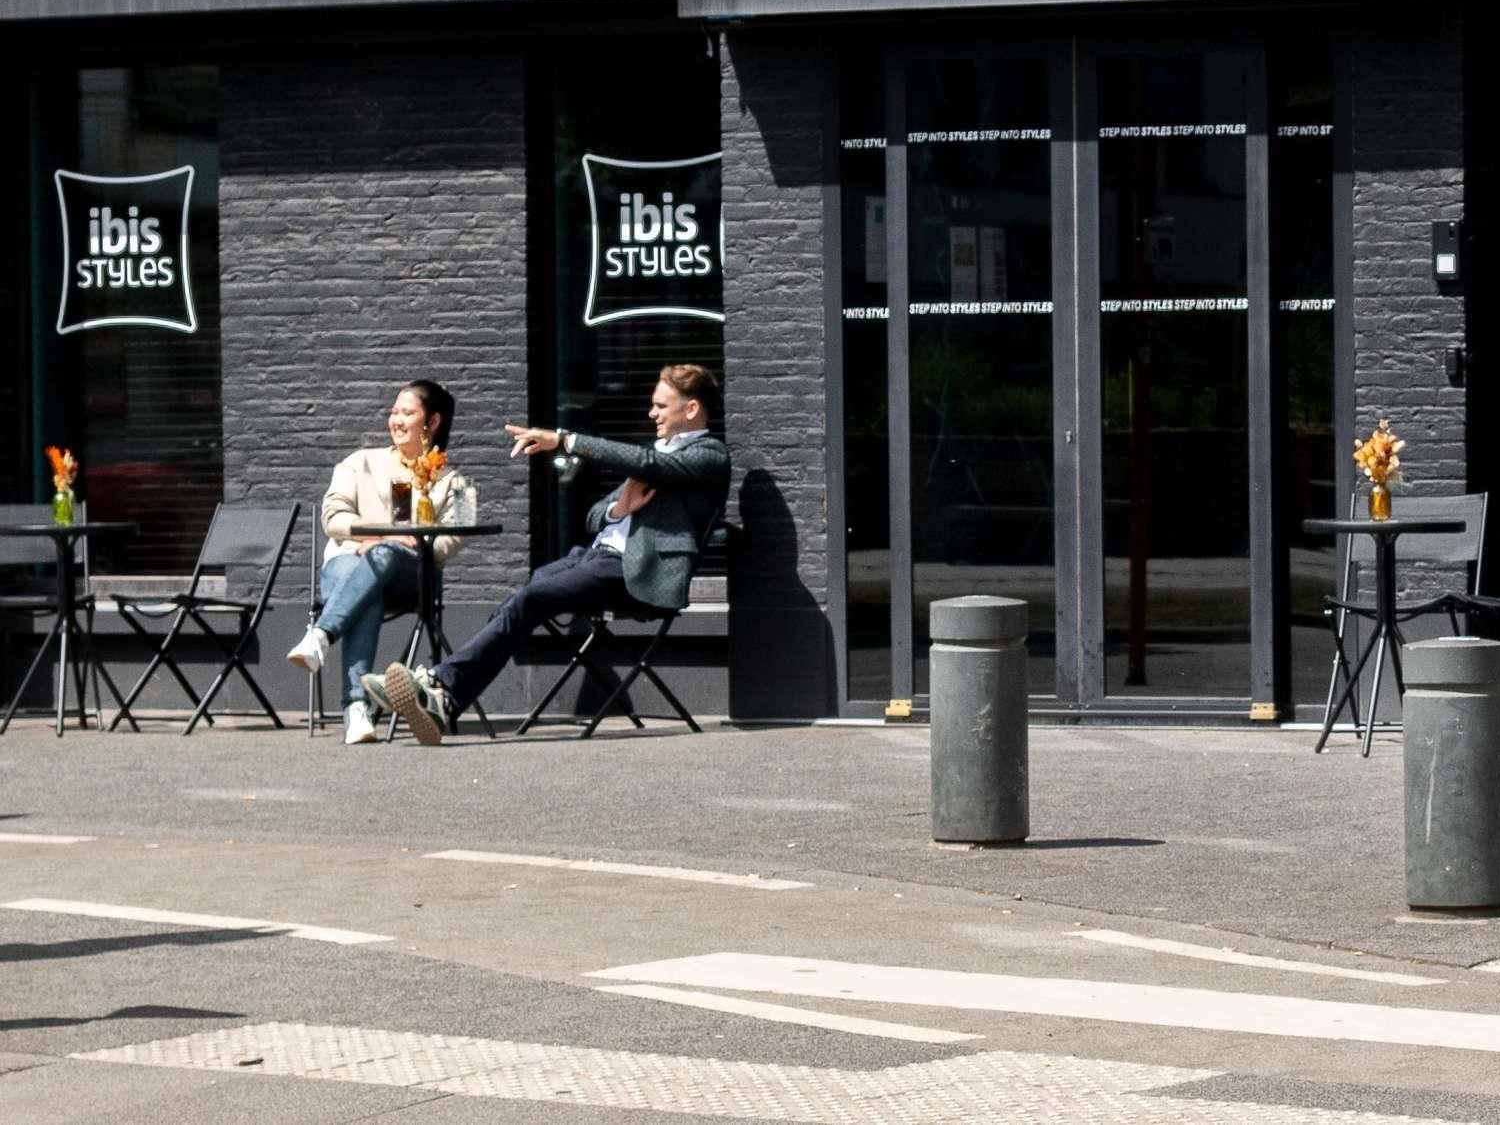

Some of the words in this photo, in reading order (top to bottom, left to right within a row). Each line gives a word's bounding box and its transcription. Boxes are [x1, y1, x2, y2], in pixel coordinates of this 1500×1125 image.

[907, 132, 928, 143] STEP
[928, 132, 947, 142] INTO
[948, 131, 978, 142] STYLES
[979, 131, 1000, 141] STEP
[1000, 130, 1020, 140] INTO
[1020, 129, 1051, 139] STYLES
[1099, 127, 1120, 137] STEP
[1120, 127, 1140, 137] INTO
[1141, 125, 1172, 136] STYLES
[1172, 125, 1194, 136] STEP
[1194, 125, 1214, 135] INTO
[1215, 124, 1247, 135] STYLES
[1277, 126, 1299, 136] STEP
[1299, 125, 1319, 135] INTO
[844, 139, 863, 149] INTO
[620, 192, 697, 243] ibis
[89, 206, 162, 255] ibis
[909, 303, 930, 315] STEP
[930, 303, 949, 314] INTO
[950, 302, 980, 314] STYLES
[981, 302, 1001, 314] STEP
[1002, 302, 1021, 313] INTO
[1022, 301, 1054, 313] STYLES
[1100, 300, 1121, 311] STEP
[1121, 300, 1141, 311] INTO
[1142, 299, 1173, 311] STYLES
[1174, 299, 1196, 310] STEP
[1196, 299, 1215, 310] INTO
[1216, 298, 1249, 309] STYLES
[1279, 299, 1300, 311] STEP
[1301, 299, 1320, 310] INTO
[846, 308, 865, 319] INTO
